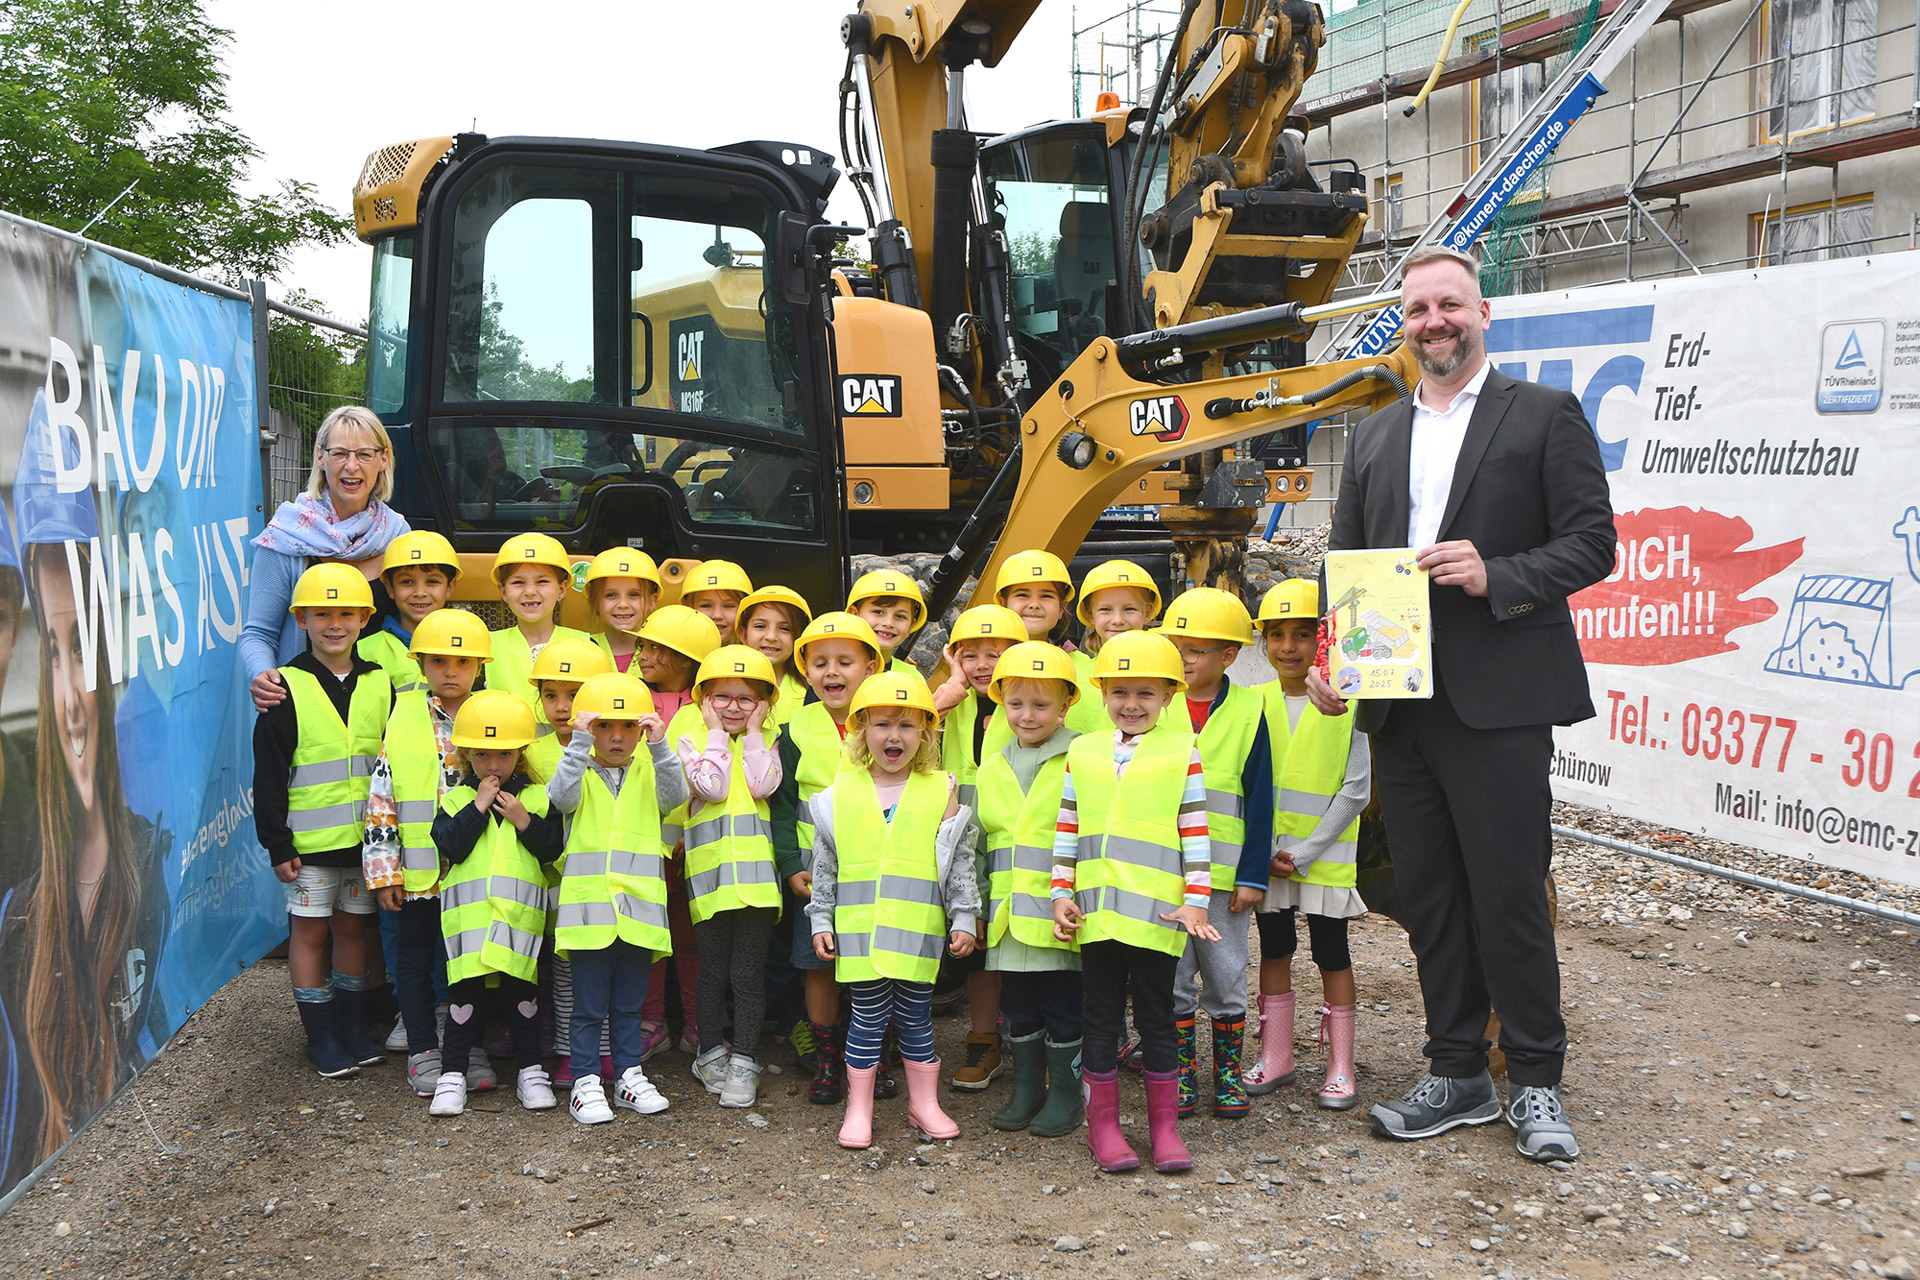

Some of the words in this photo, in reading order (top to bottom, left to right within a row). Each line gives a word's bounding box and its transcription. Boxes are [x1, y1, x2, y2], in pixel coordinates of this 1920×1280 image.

[678, 331, 704, 381] CAT
[1664, 332, 1711, 368] Erd-
[46, 336, 166, 493] BAU
[176, 358, 226, 489] DIR
[842, 378, 895, 414] CAT
[1653, 385, 1702, 421] Tief-
[1823, 394, 1873, 405] ZERTIFIZIERT
[1130, 396, 1175, 436] CAT
[1641, 438, 1860, 477] Umweltschutzbau
[64, 528, 186, 693] WAS
[194, 517, 249, 656] AUF
[1370, 680, 1392, 688] 2025
[1607, 689, 1669, 751] Tel.:
[1682, 703, 1797, 773] 03377
[1842, 728, 1894, 792] 30
[1715, 782, 1767, 823] Mail:
[1775, 794, 1920, 858] info@emc-z
